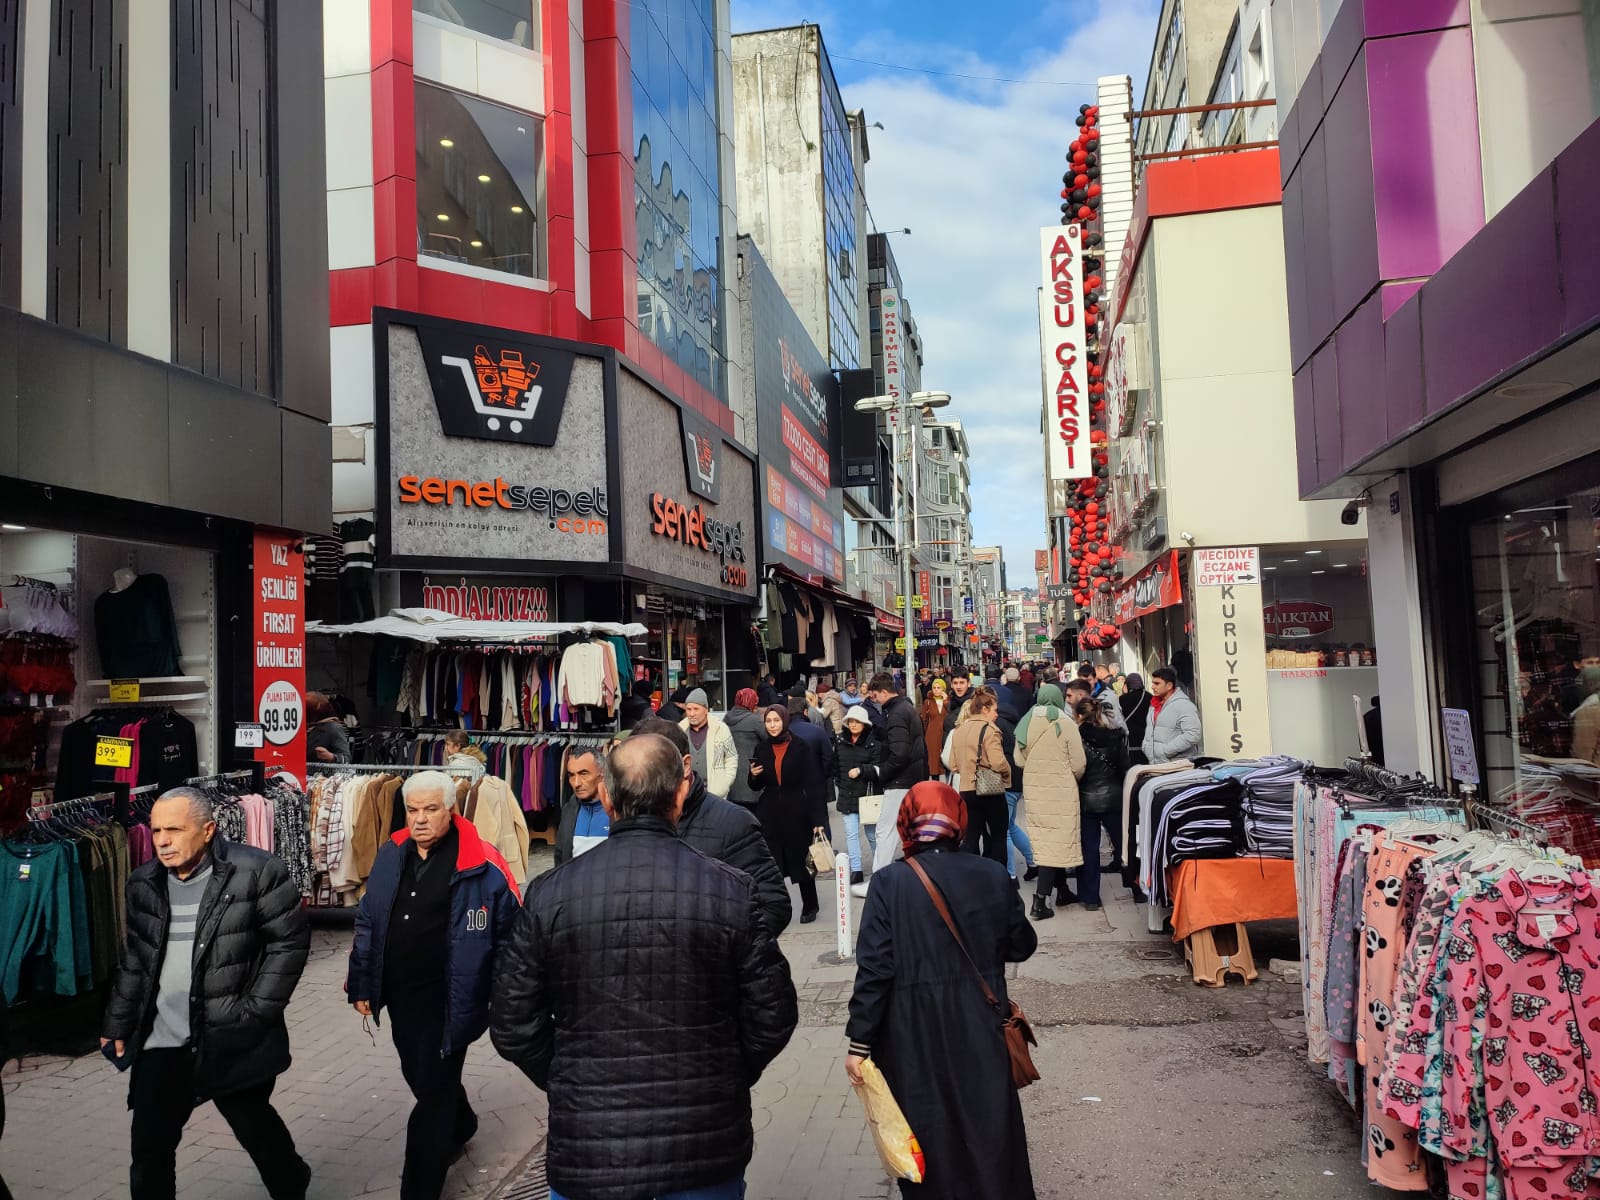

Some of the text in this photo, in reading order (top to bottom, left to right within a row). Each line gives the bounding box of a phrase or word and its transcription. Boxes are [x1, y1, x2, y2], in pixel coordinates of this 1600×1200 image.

[884, 312, 898, 374] HANIMLAR
[1050, 234, 1080, 469] AKSU ÇARŞI
[399, 475, 608, 518] senetsepet
[548, 517, 606, 534] .com
[270, 543, 288, 566] YAZ
[1198, 547, 1255, 561] MECİDİYE
[721, 565, 746, 587] .com
[1199, 572, 1235, 584] OPTİK
[1203, 562, 1251, 572] ECZANE
[261, 576, 297, 603] ŞENLİĞİ
[422, 576, 548, 622] İDDİALIYIZ!!!
[263, 612, 296, 634] FIRSAT
[1263, 611, 1330, 624] HALKTAN
[256, 641, 303, 668] ÜRÜNLERİ
[1221, 585, 1243, 753] KURUYEMİŞ
[1281, 670, 1327, 679] HALKTAN
[264, 707, 298, 733] 99.99
[239, 730, 254, 739] 199
[97, 746, 116, 757] 399
[467, 909, 487, 931] 10
